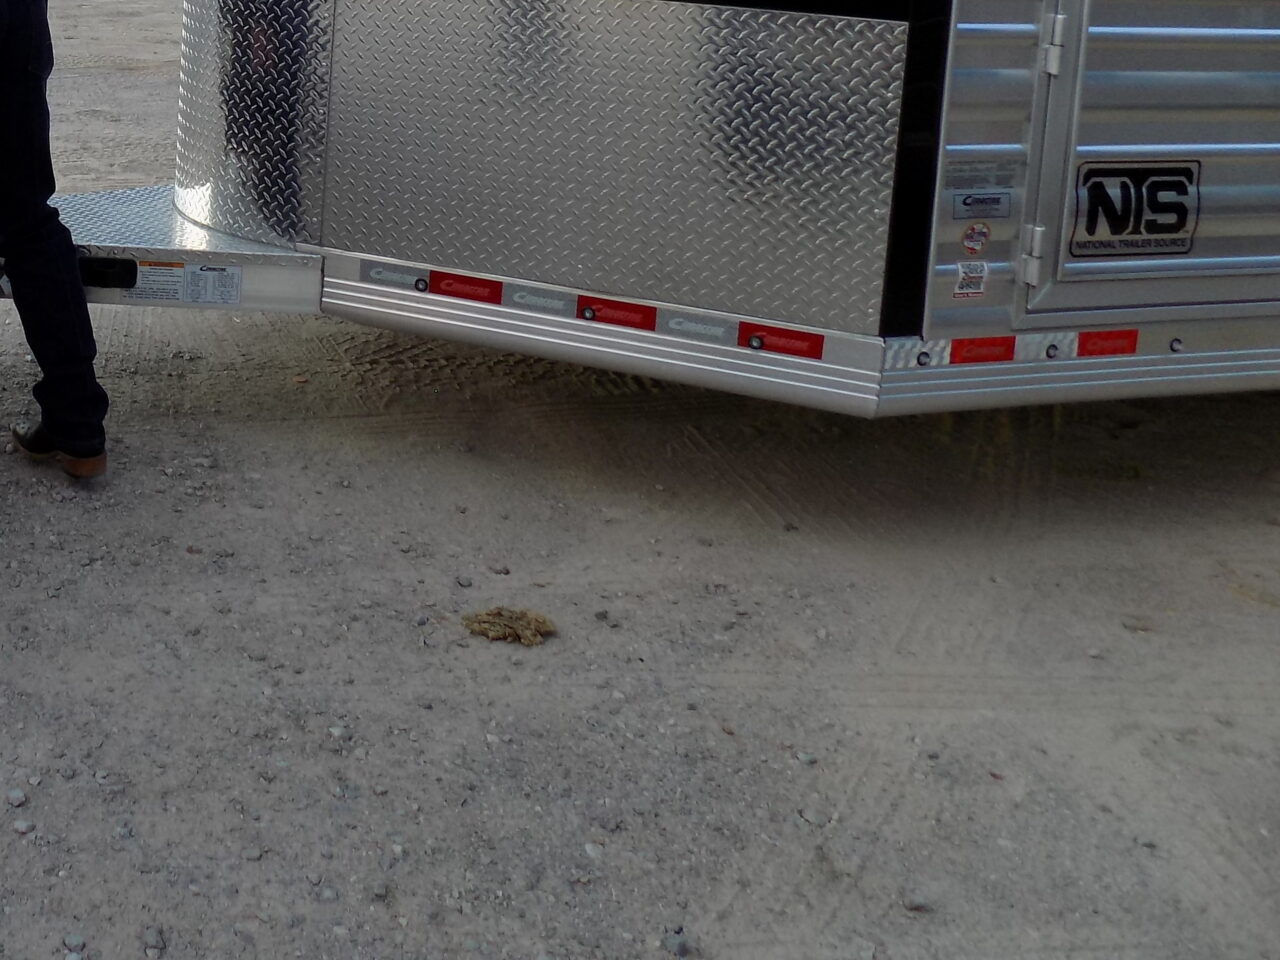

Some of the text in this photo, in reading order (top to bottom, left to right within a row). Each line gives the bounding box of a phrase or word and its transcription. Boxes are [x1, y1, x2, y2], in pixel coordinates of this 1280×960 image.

[1075, 238, 1188, 250] NATIONAL TRAILER SOURCE
